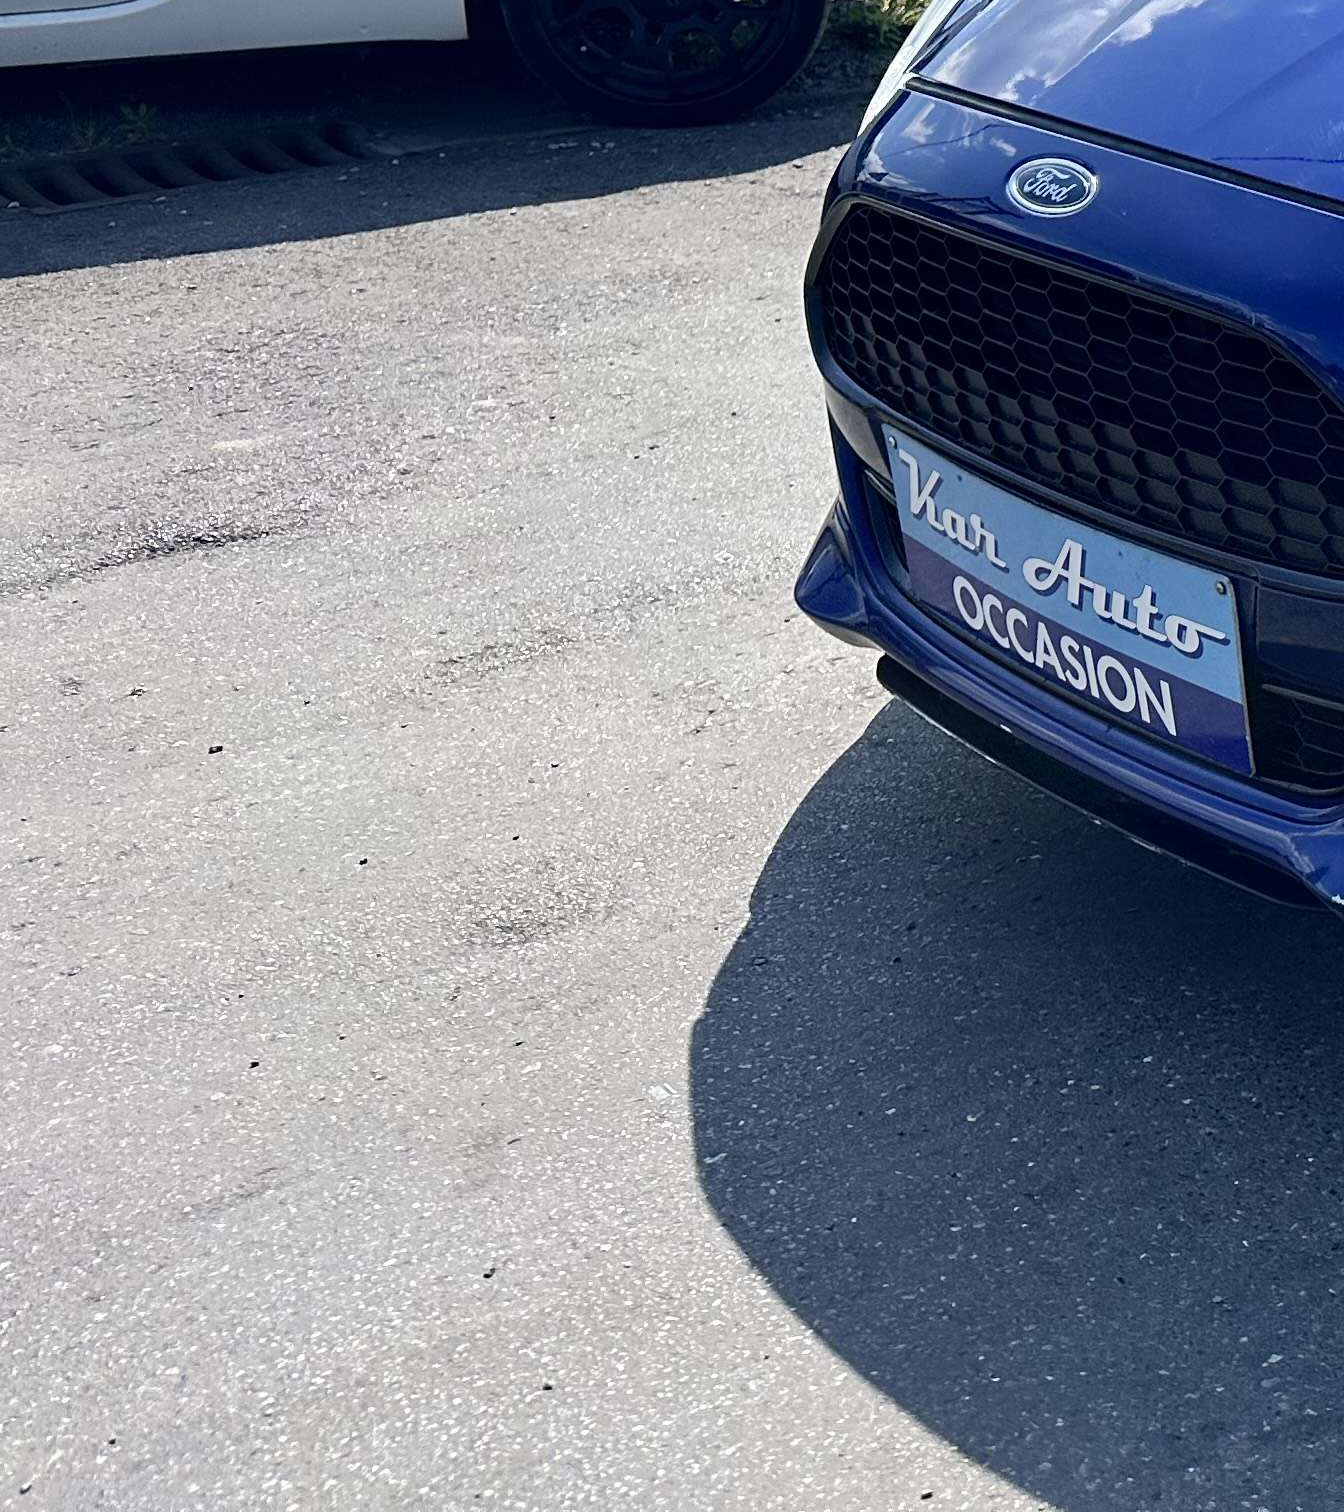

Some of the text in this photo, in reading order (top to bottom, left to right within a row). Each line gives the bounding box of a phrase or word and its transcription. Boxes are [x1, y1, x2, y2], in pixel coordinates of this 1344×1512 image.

[1023, 167, 1078, 202] Ford
[899, 448, 1230, 656] Kar Auto
[952, 575, 1178, 737] OCCASION
